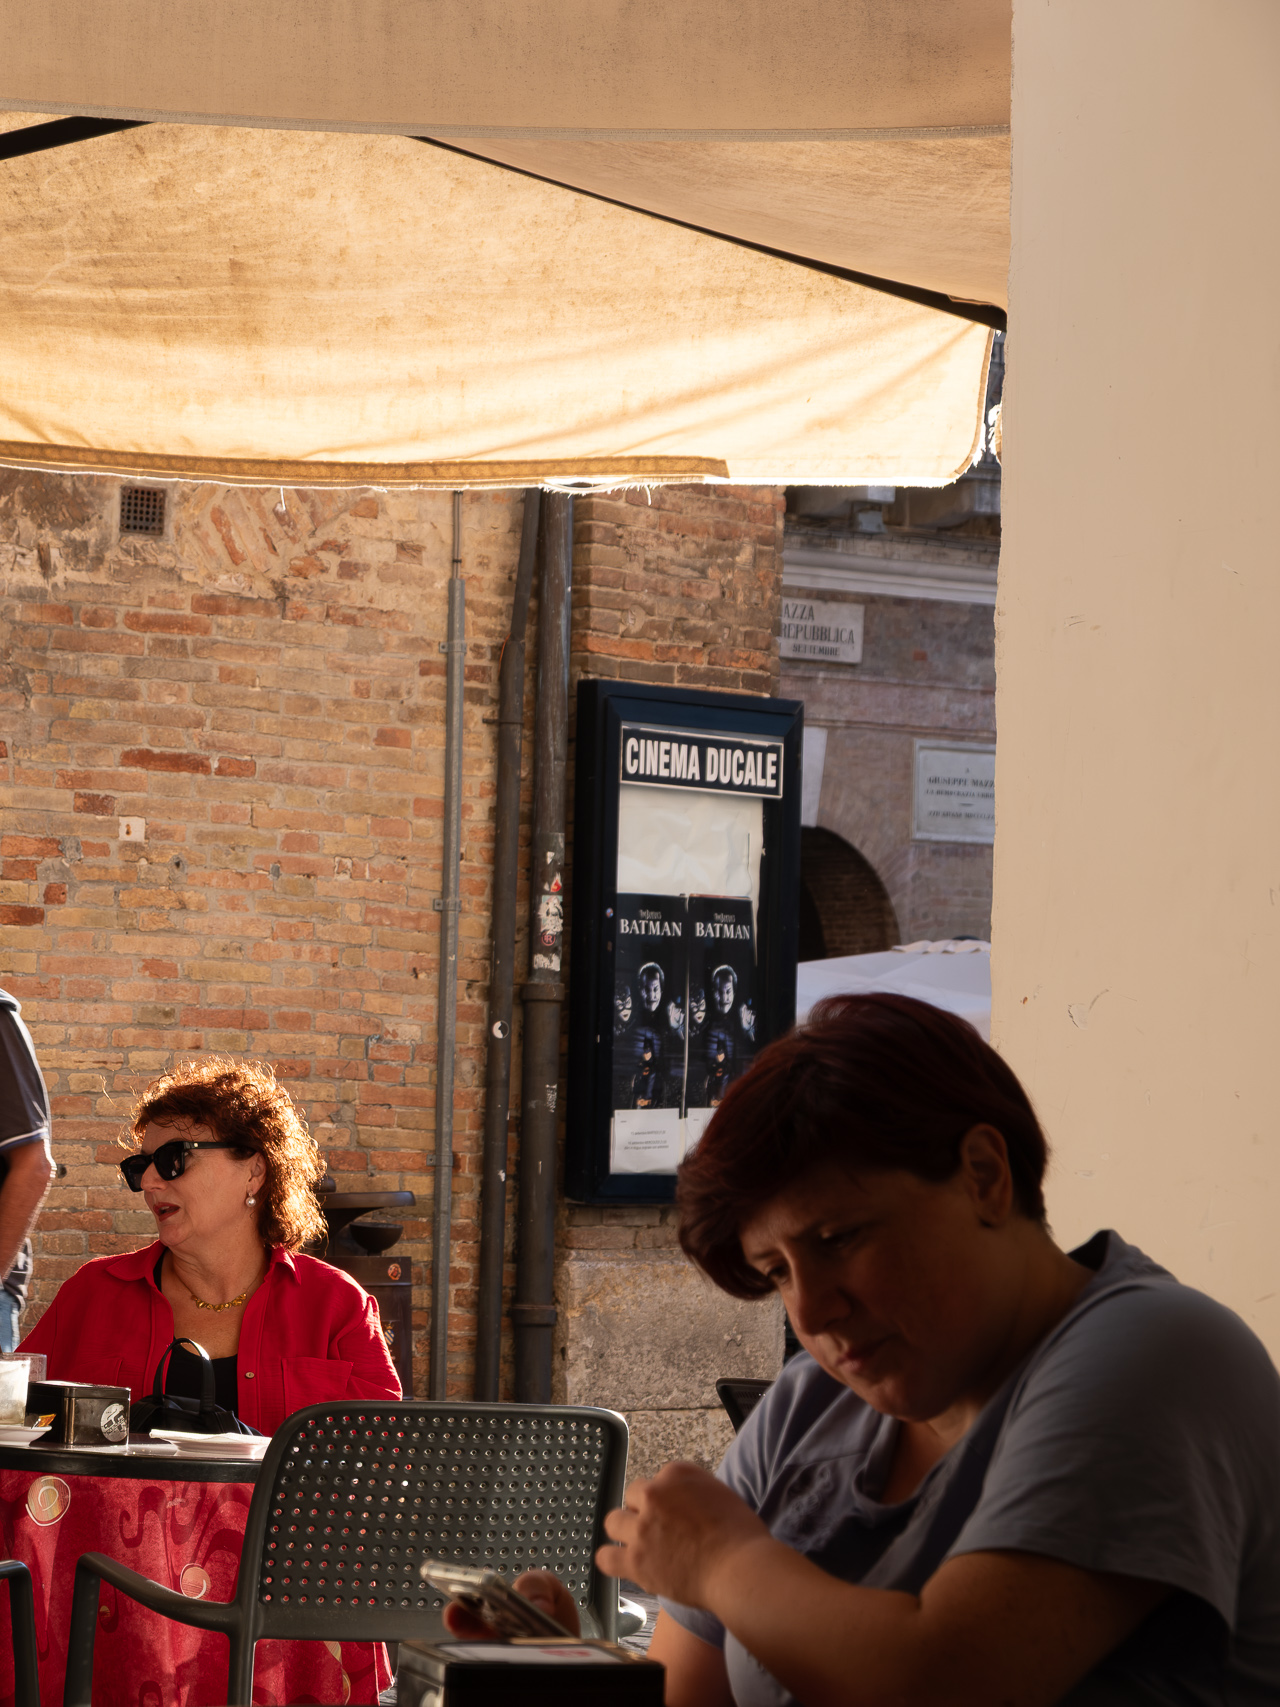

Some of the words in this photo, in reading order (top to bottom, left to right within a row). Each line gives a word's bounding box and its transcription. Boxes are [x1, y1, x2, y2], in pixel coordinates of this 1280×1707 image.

[625, 737, 700, 781] CINEMA
[705, 746, 777, 788] DUCALE
[620, 919, 683, 937] BATMAN
[695, 922, 751, 940] BATMAN
